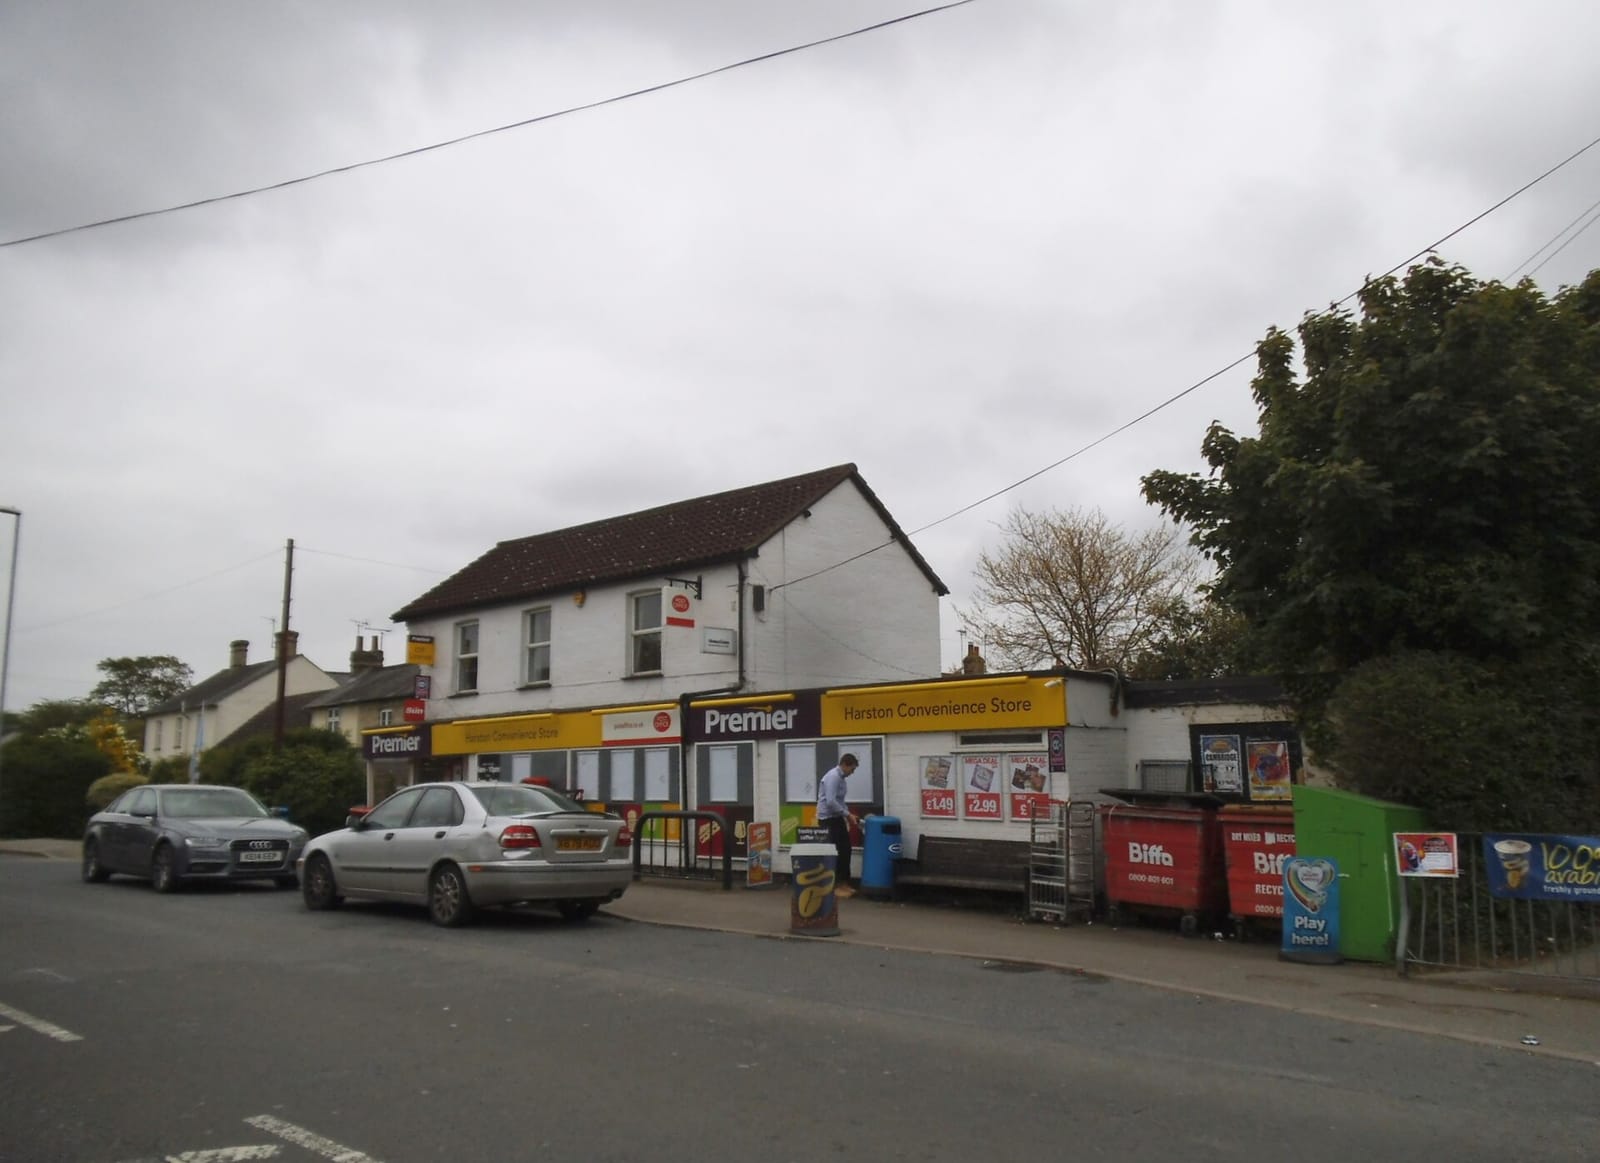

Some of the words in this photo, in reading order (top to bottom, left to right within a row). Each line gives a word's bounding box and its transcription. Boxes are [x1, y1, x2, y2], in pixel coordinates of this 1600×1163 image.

[844, 706, 893, 720] Harston
[897, 702, 986, 717] Convenience
[991, 697, 1031, 713] Store
[705, 704, 798, 734] Premier
[539, 727, 559, 738] Store
[371, 735, 421, 753] Premier
[926, 797, 954, 810] £1.49
[969, 800, 997, 813] £2.99
[1128, 842, 1174, 867] Biffa
[1255, 884, 1284, 896] RECYC
[1294, 915, 1326, 932] Play
[1291, 933, 1329, 946] here!
